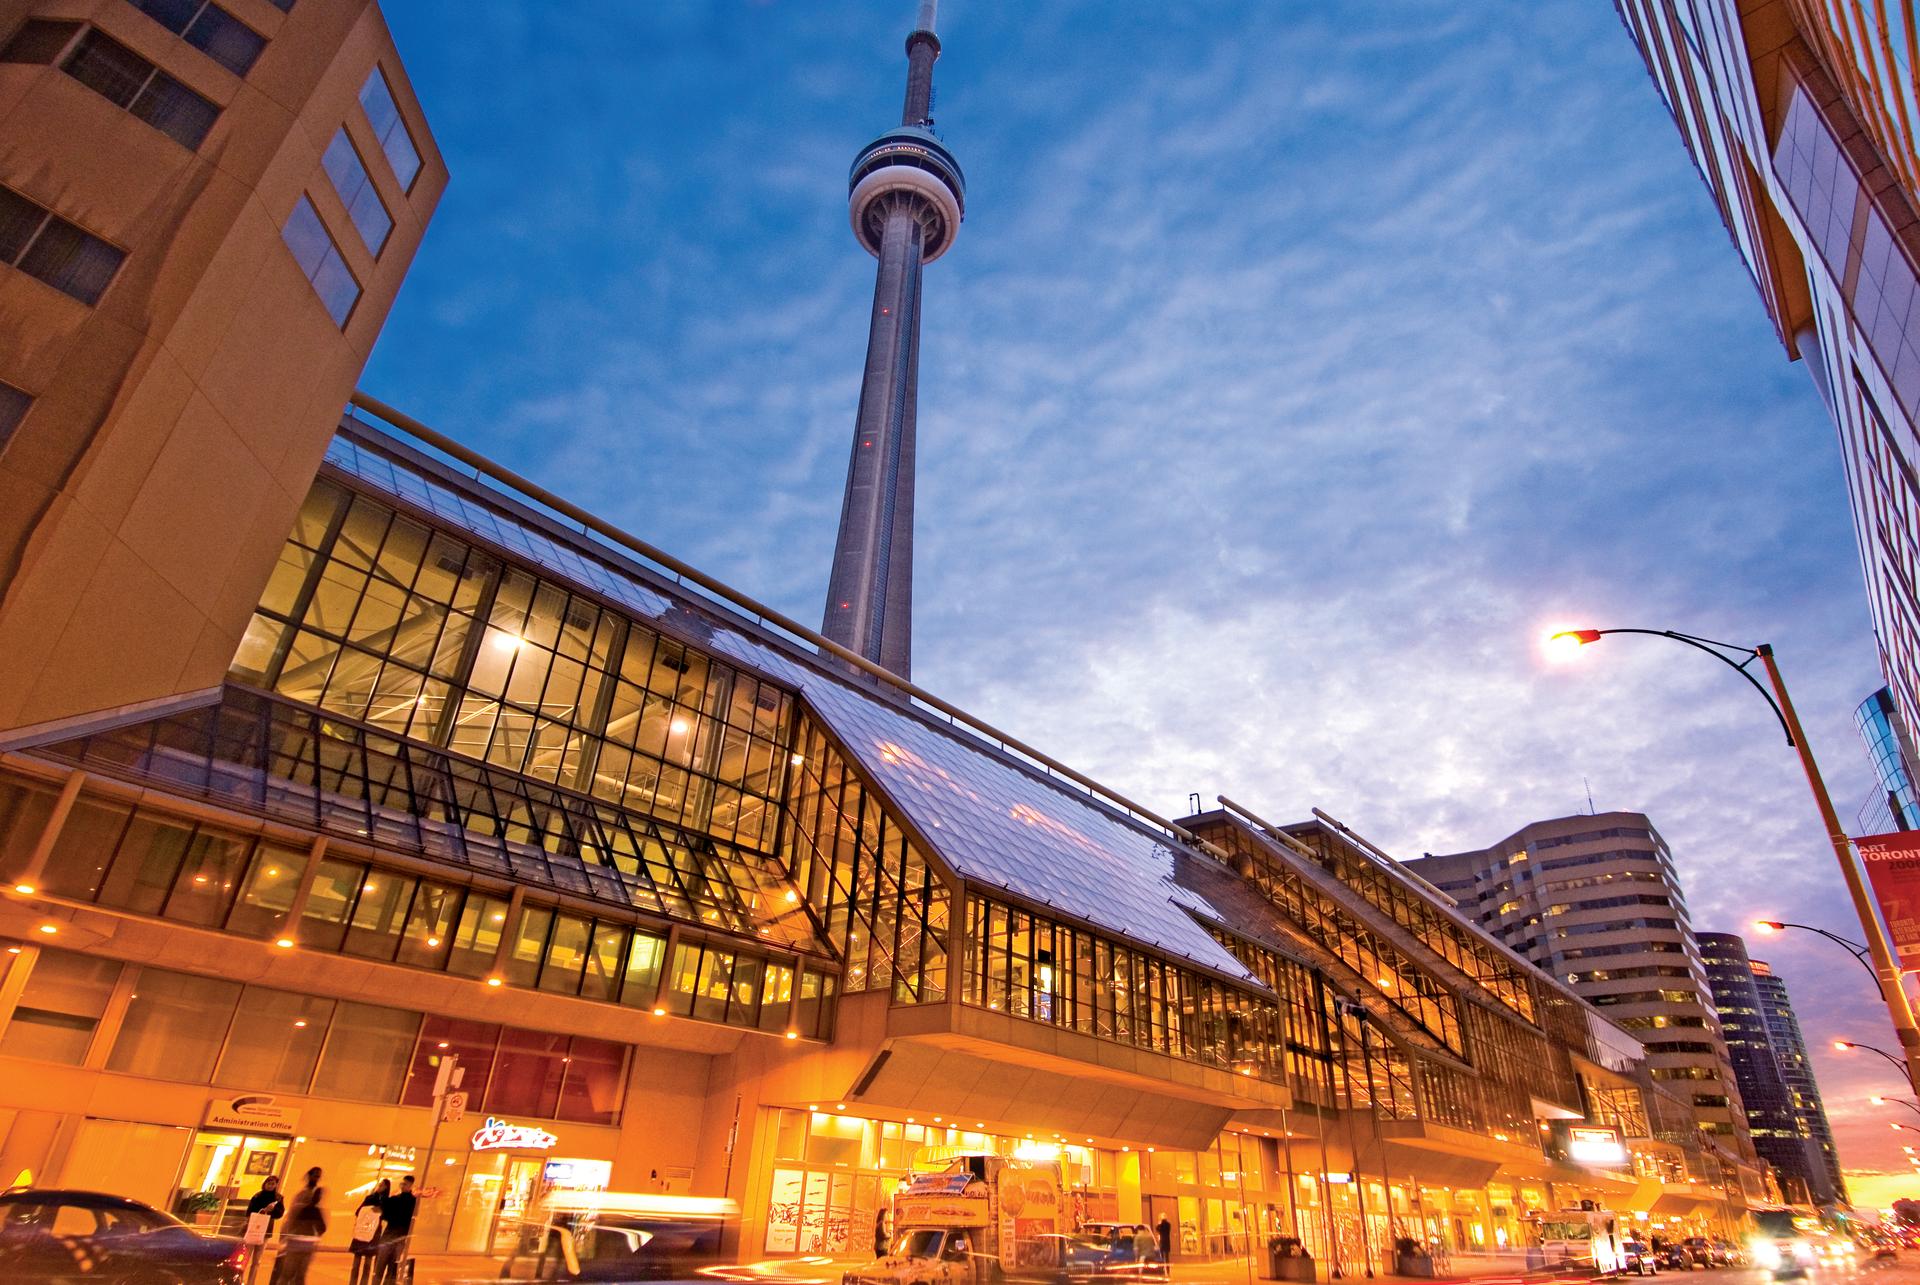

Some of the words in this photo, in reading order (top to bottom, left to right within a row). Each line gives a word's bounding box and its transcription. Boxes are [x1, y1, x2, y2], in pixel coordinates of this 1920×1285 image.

[1859, 844, 1886, 853] ART
[213, 1116, 269, 1128] Administration
[271, 1122, 292, 1130] Office
